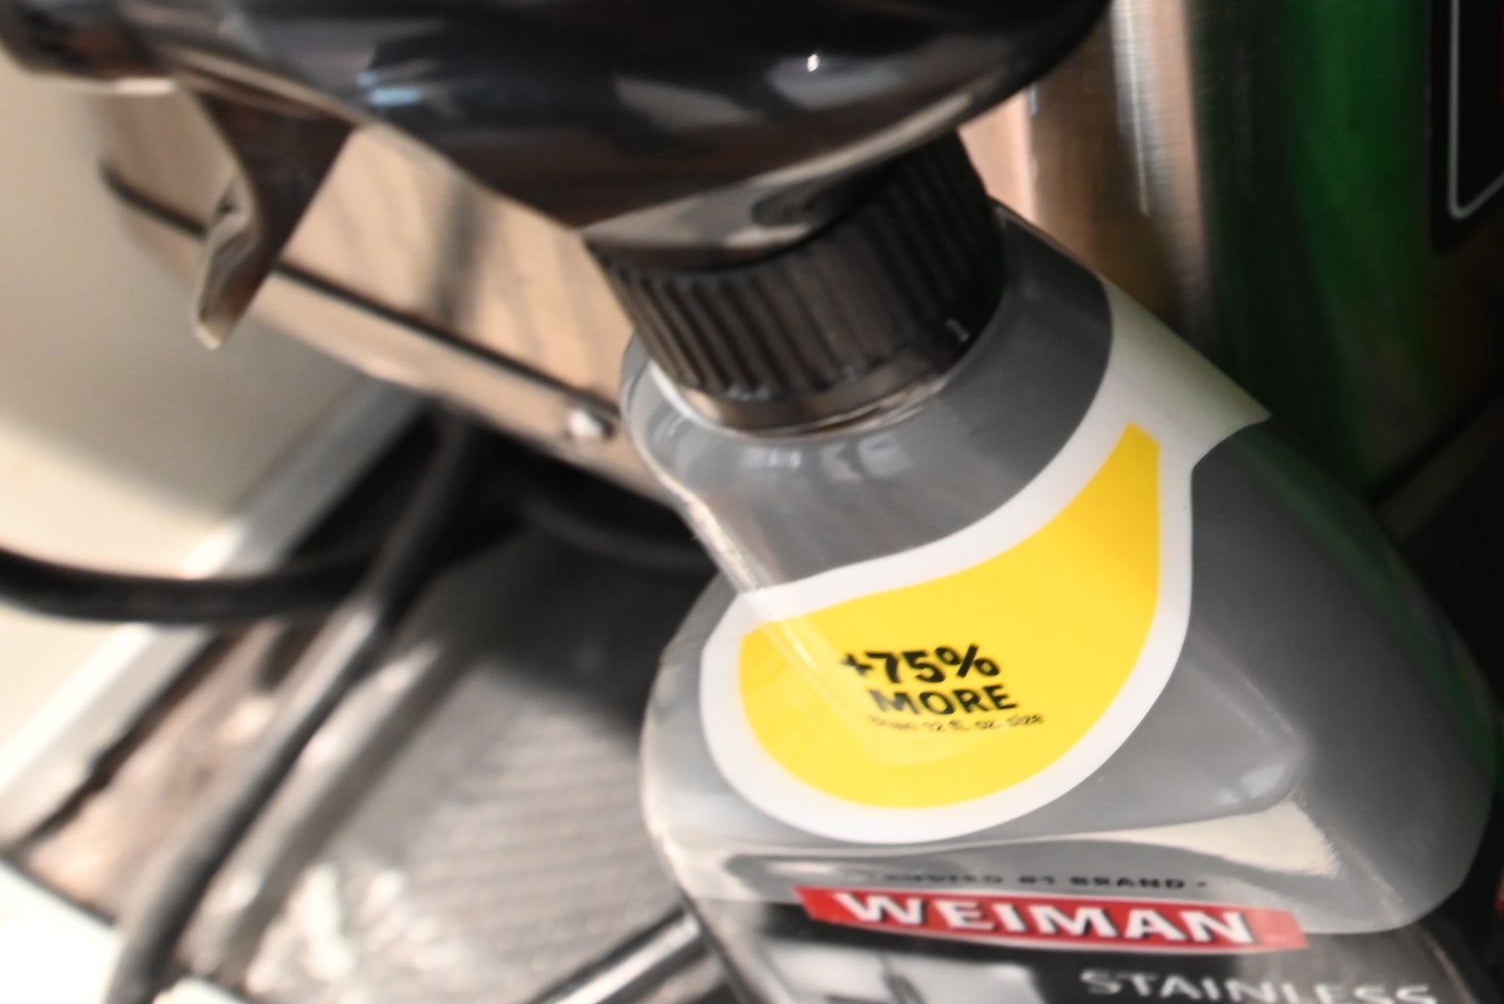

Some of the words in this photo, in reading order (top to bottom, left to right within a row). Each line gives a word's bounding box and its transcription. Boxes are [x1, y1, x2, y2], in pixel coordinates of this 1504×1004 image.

[840, 642, 1002, 685] +75%
[866, 683, 1019, 716] MORE
[1066, 875, 1184, 890] BRAND
[834, 890, 1256, 945] WEIMAN
[1081, 968, 1438, 1004] STAINLESS
